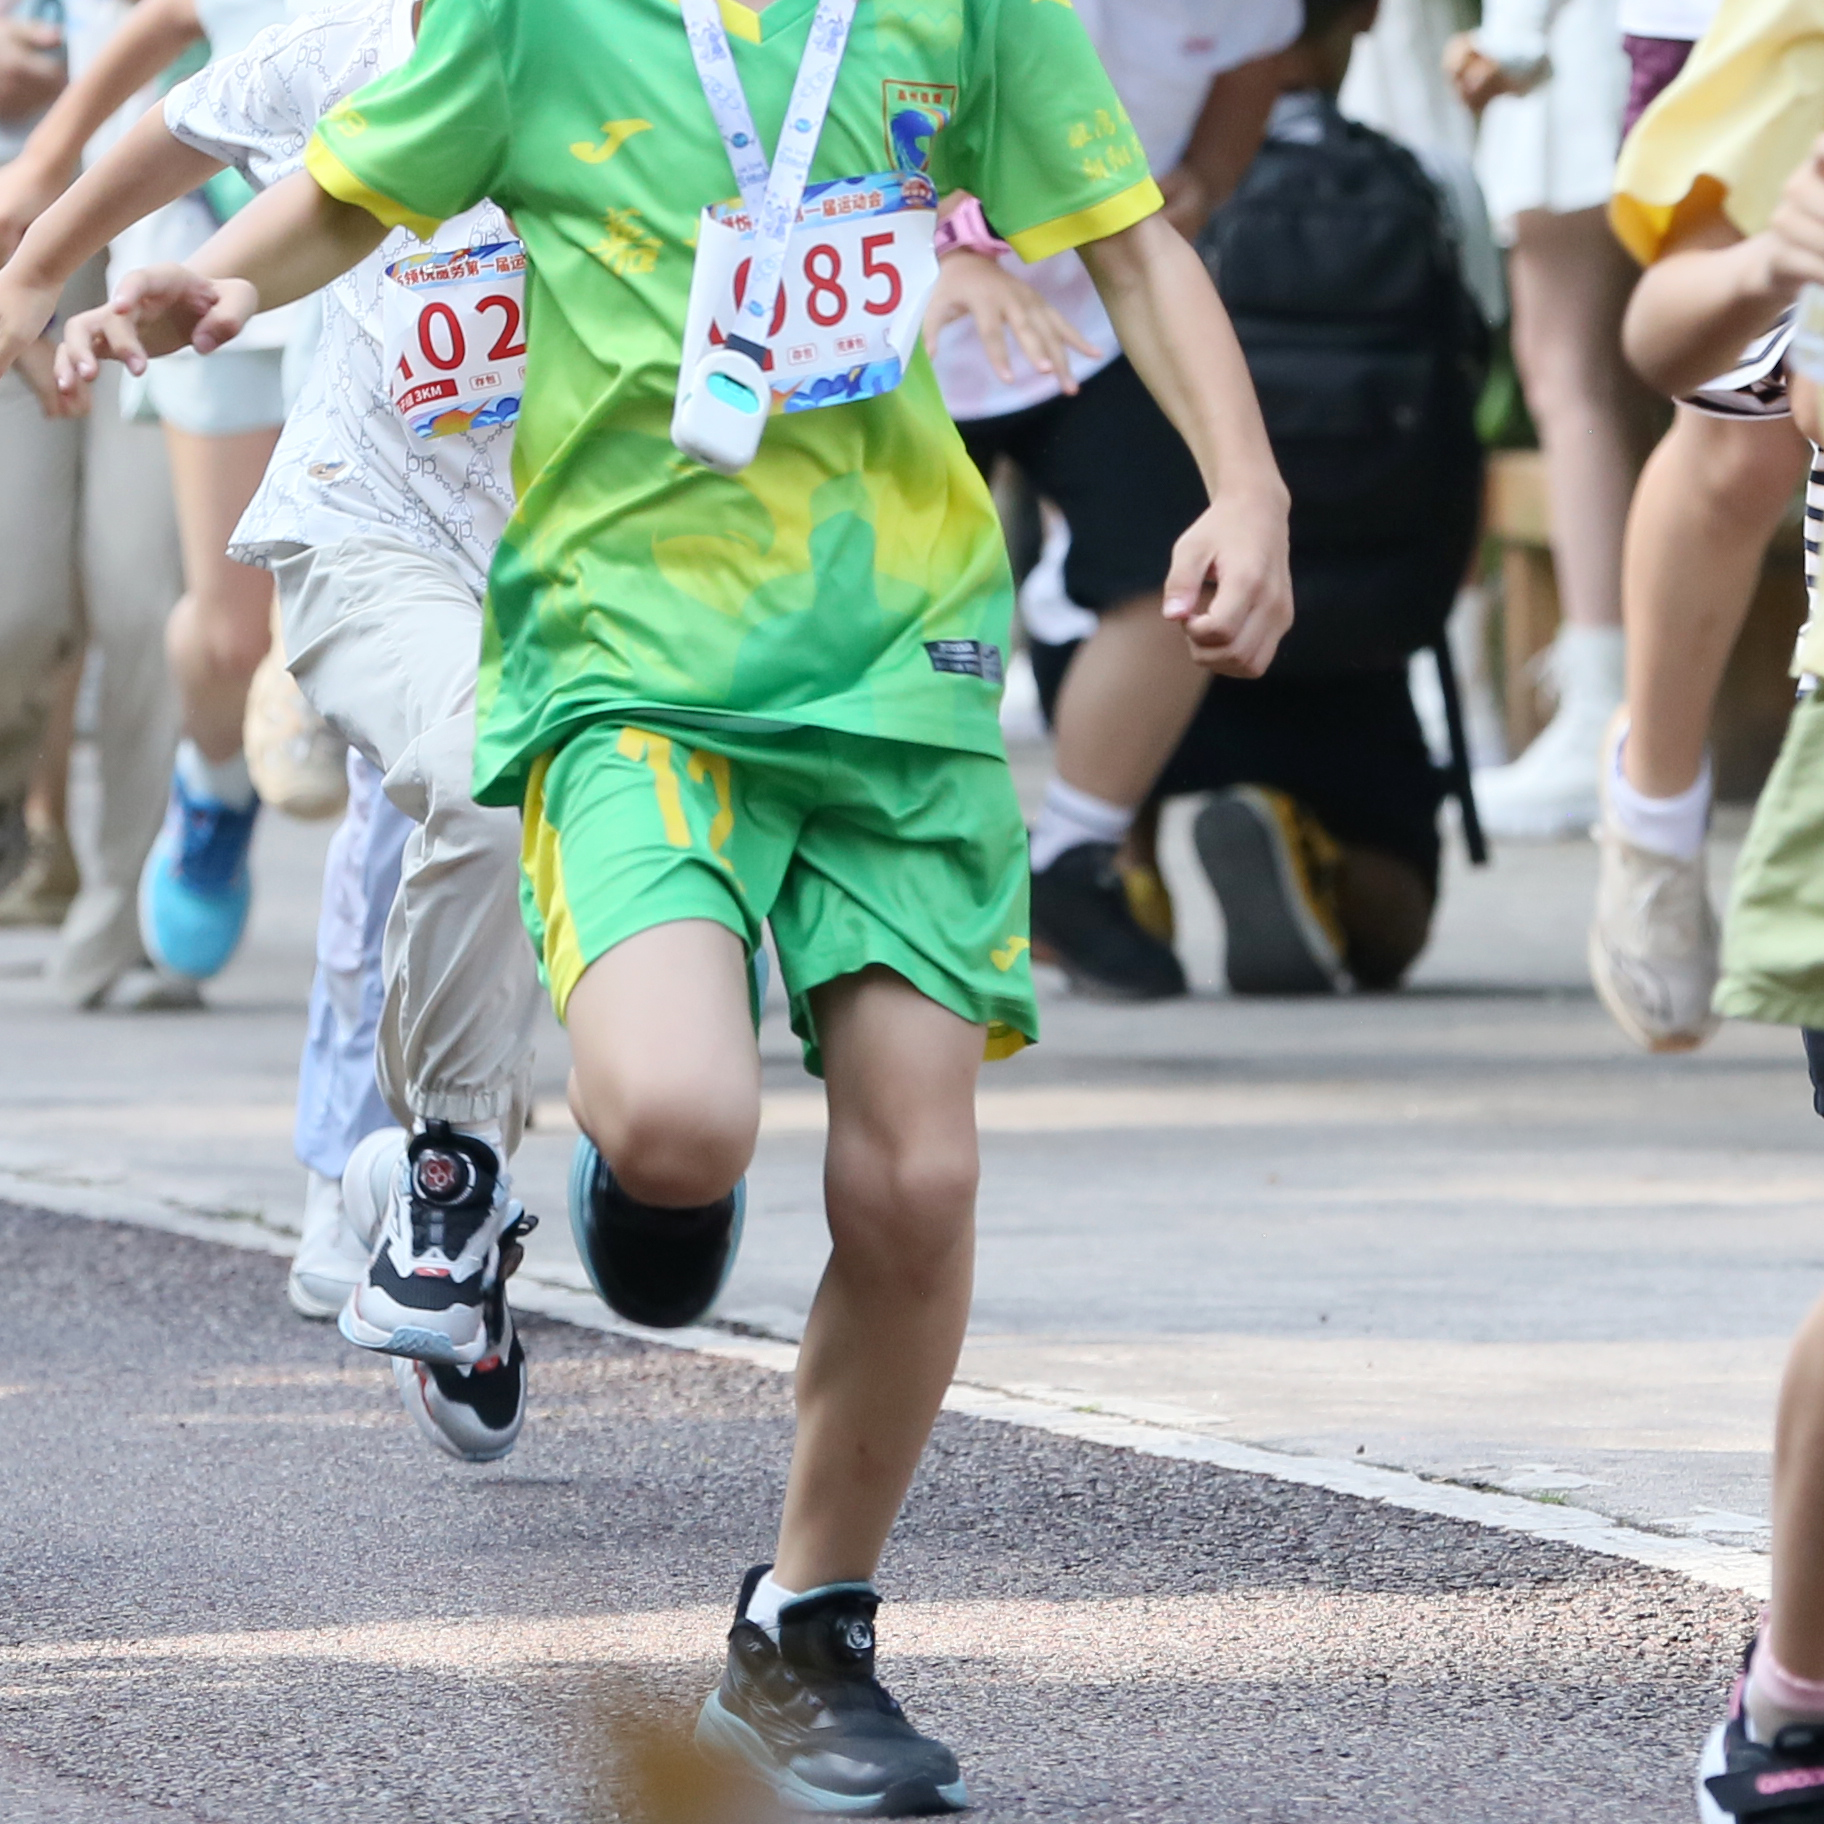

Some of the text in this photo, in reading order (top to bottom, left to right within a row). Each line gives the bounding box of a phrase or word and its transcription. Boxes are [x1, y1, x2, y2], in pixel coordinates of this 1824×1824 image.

[709, 231, 902, 371] 085
[474, 374, 496, 388] 存包
[415, 384, 443, 403] 3KM
